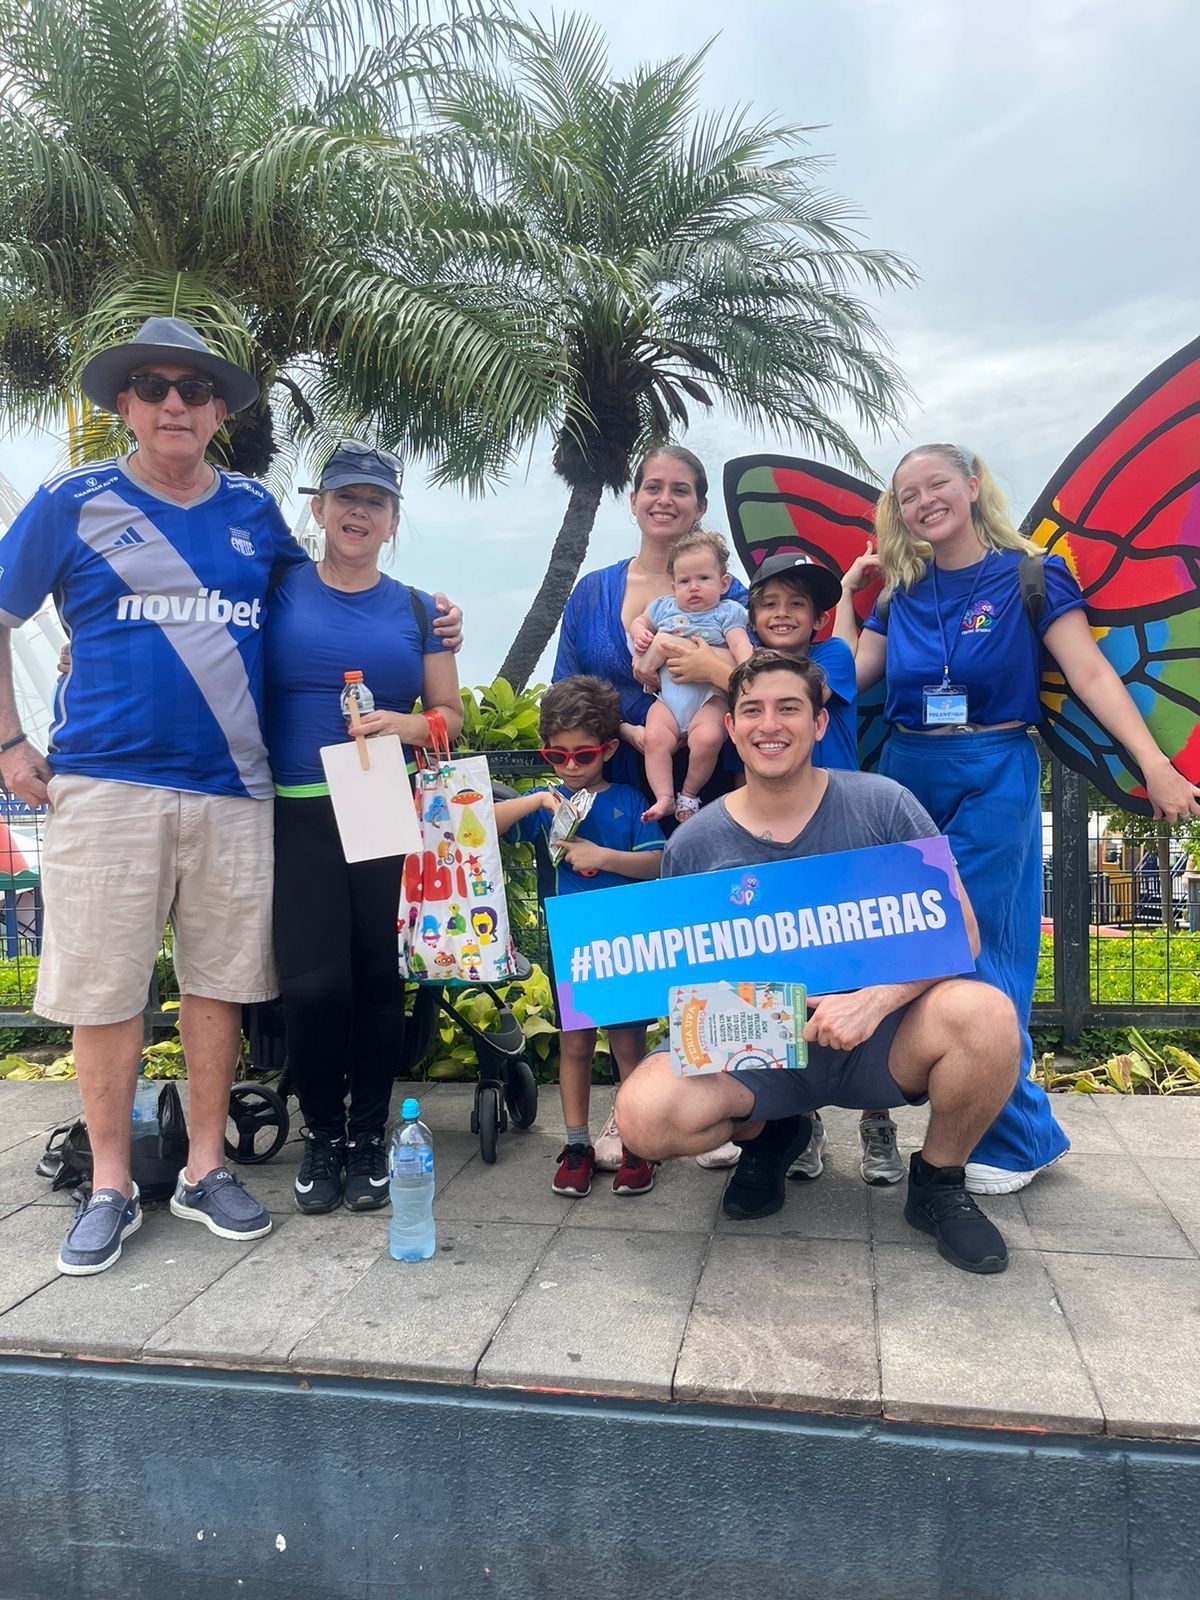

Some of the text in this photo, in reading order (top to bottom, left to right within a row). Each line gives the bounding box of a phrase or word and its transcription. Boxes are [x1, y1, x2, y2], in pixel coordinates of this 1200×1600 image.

[103, 476, 119, 488] AUTO
[116, 587, 262, 630] novibet
[570, 888, 948, 983] #ROMPIENDOBARRERAS
[684, 1005, 700, 1062] FERIA UPA
[697, 1010, 710, 1052] AUTISMO
